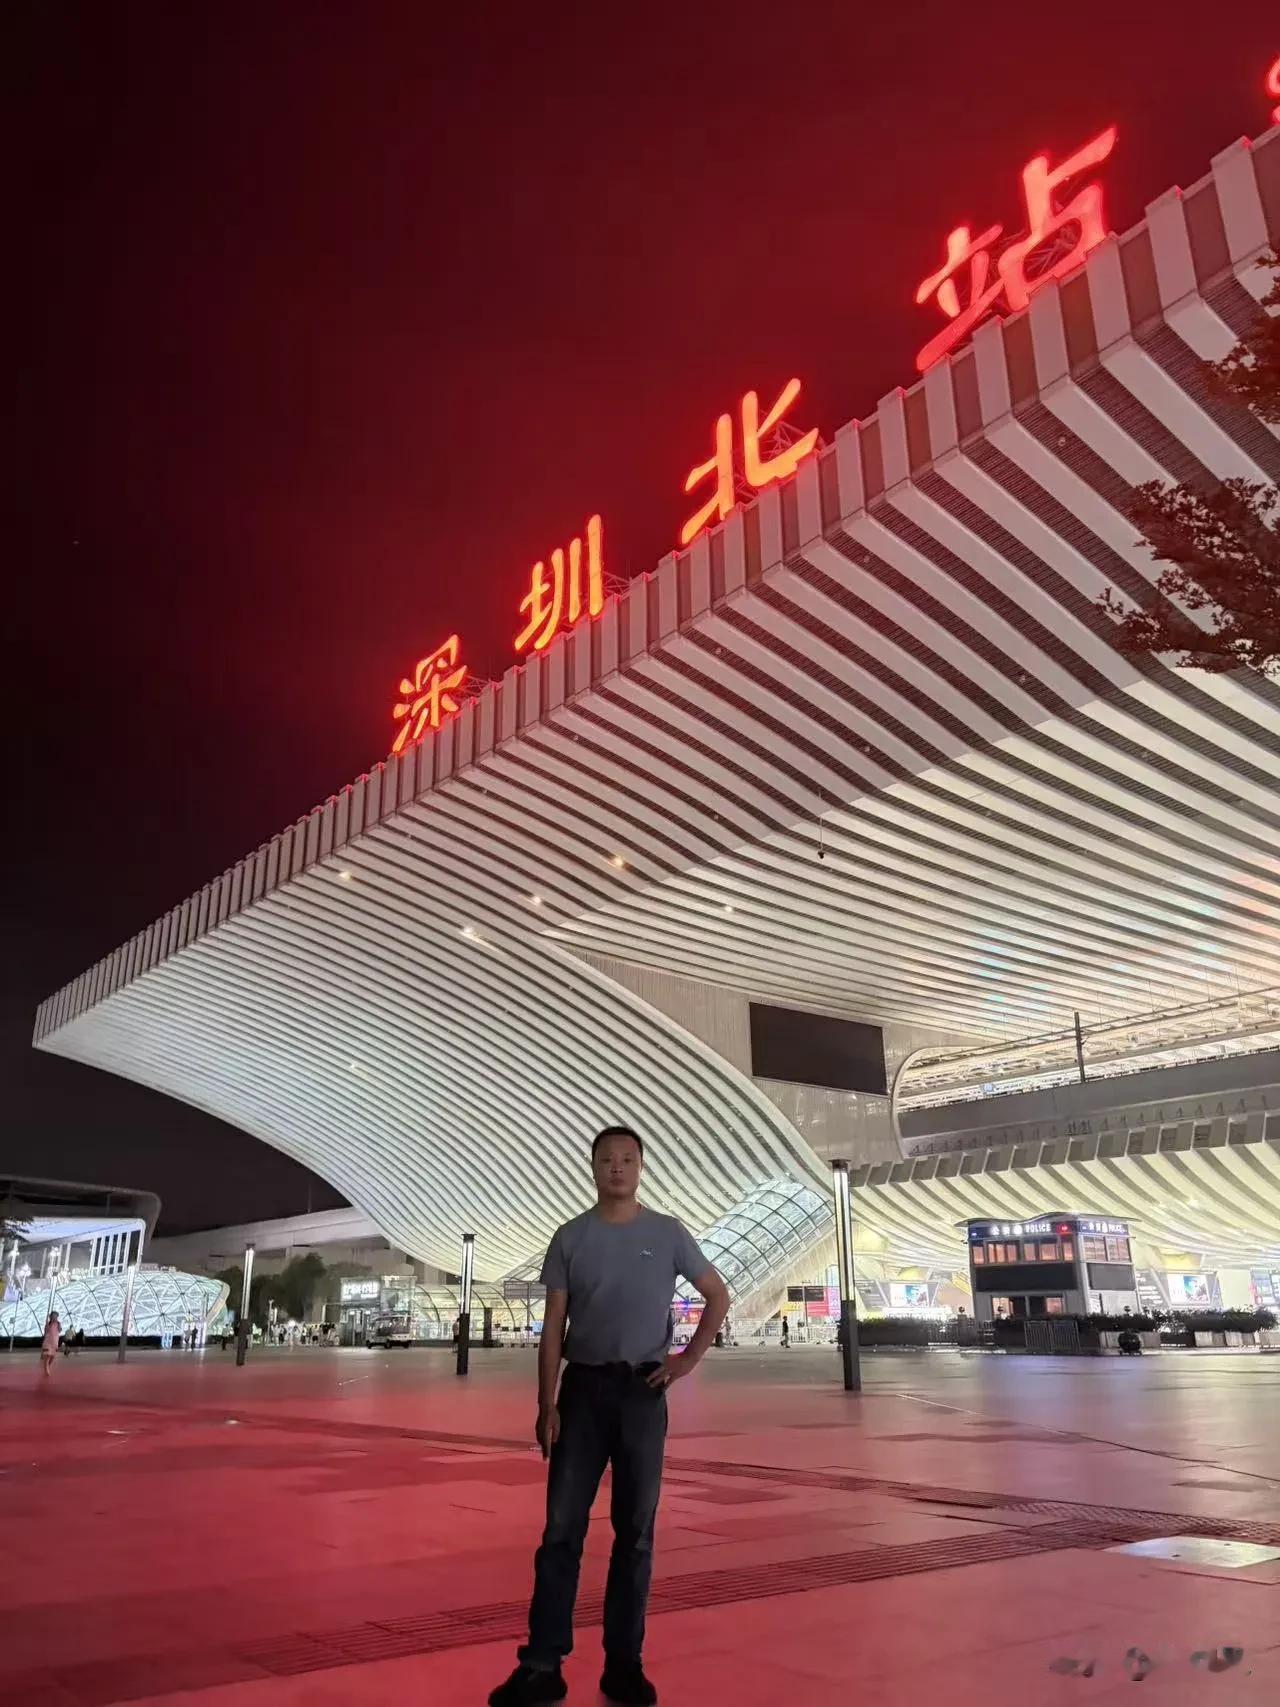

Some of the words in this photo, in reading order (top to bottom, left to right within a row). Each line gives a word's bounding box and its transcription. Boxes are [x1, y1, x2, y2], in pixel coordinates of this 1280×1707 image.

[391, 126, 1117, 753] 深圳北站
[1025, 1222, 1051, 1233] POLICE
